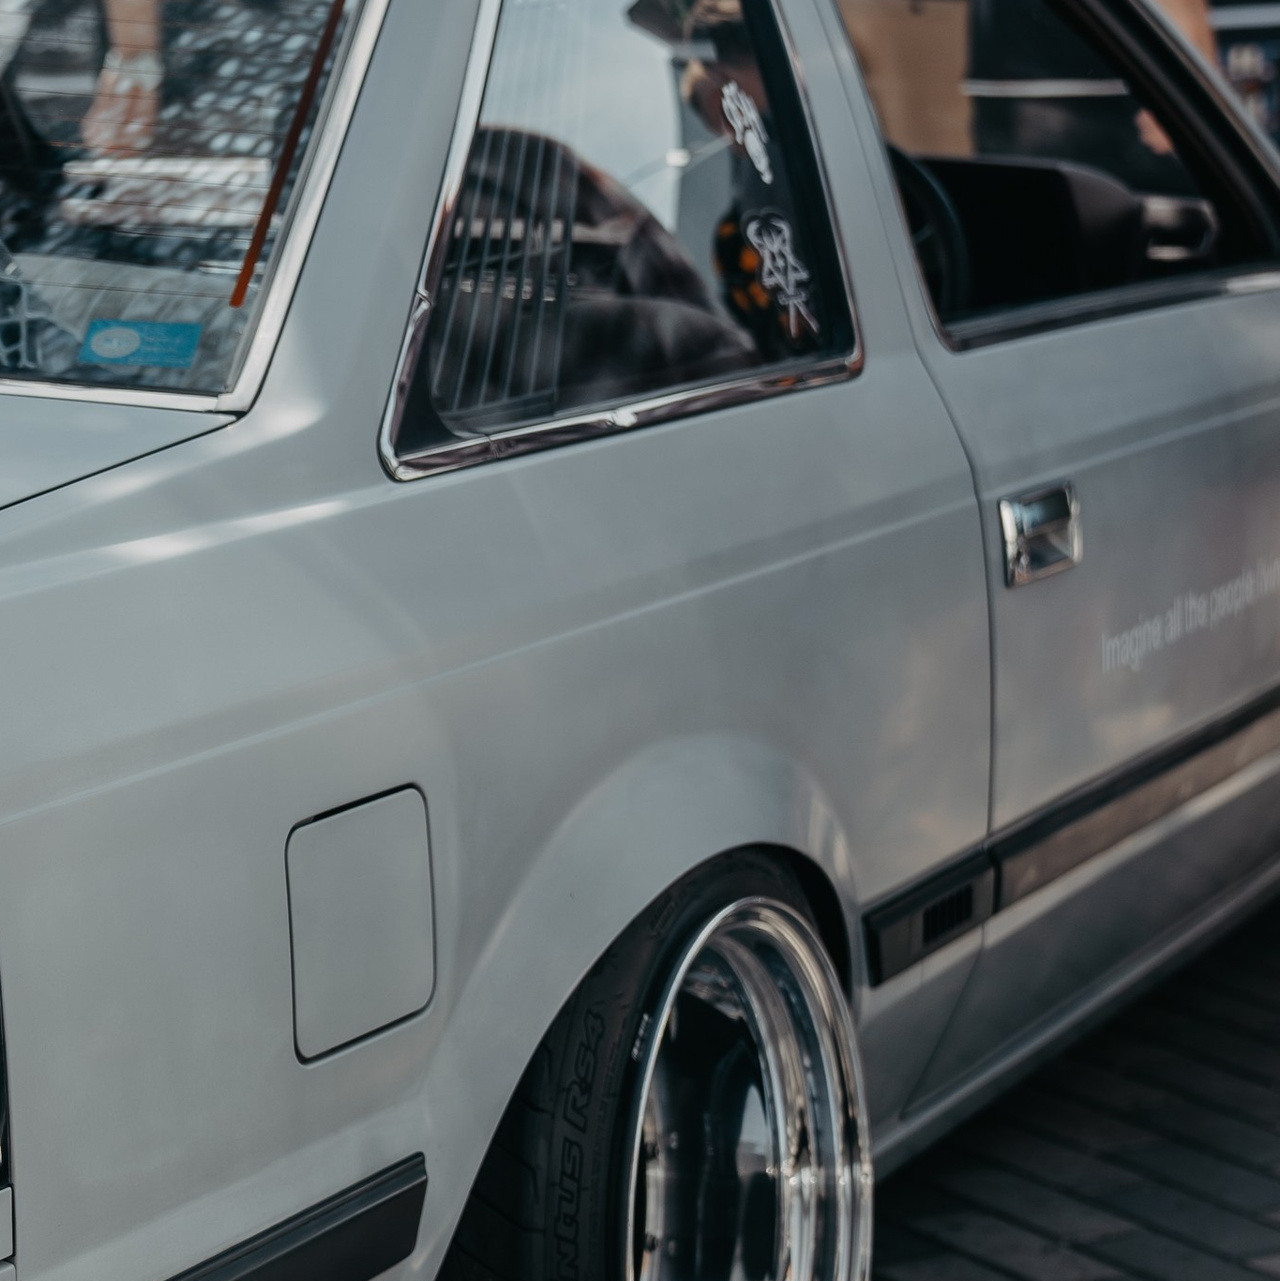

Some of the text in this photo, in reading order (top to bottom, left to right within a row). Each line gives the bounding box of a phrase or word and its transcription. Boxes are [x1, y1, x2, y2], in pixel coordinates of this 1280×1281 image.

[1101, 612, 1162, 673] Imagine
[1164, 595, 1182, 643] all
[1184, 588, 1208, 632] the
[1209, 568, 1255, 631] people
